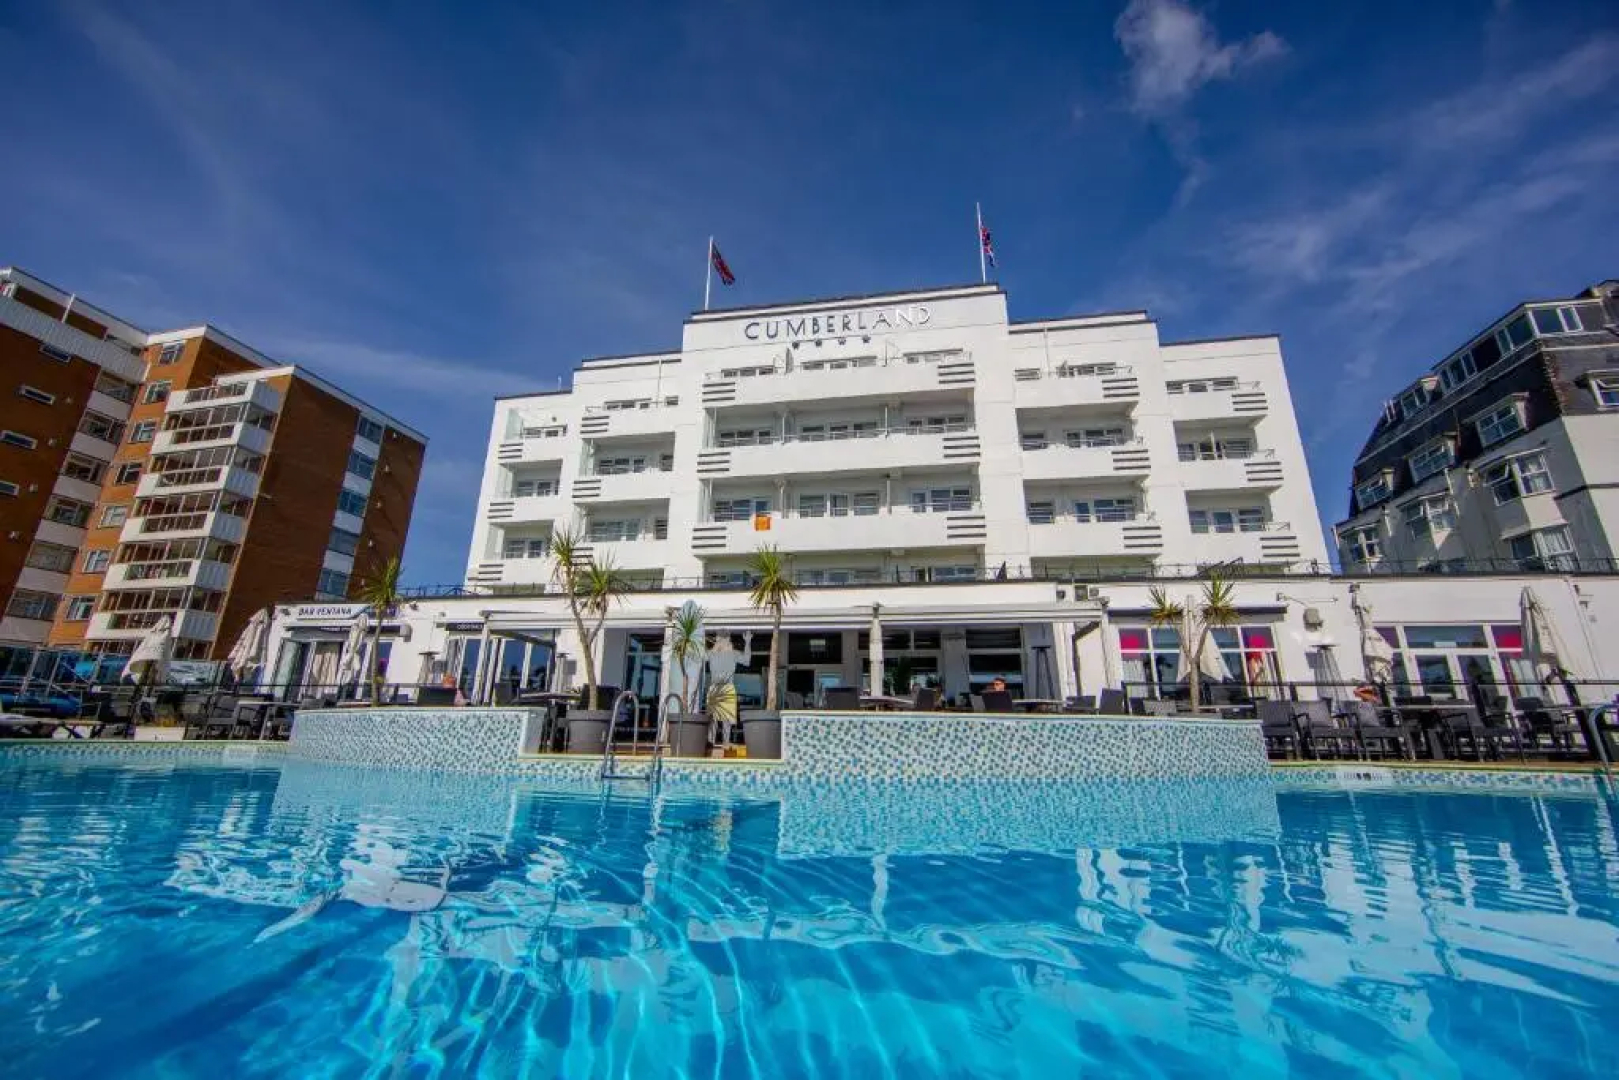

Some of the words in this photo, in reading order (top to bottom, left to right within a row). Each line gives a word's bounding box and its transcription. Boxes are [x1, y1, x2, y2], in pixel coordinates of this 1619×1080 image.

[745, 307, 931, 340] CUMBERLAND
[298, 607, 316, 616] BAR
[317, 607, 352, 616] VENTANA
